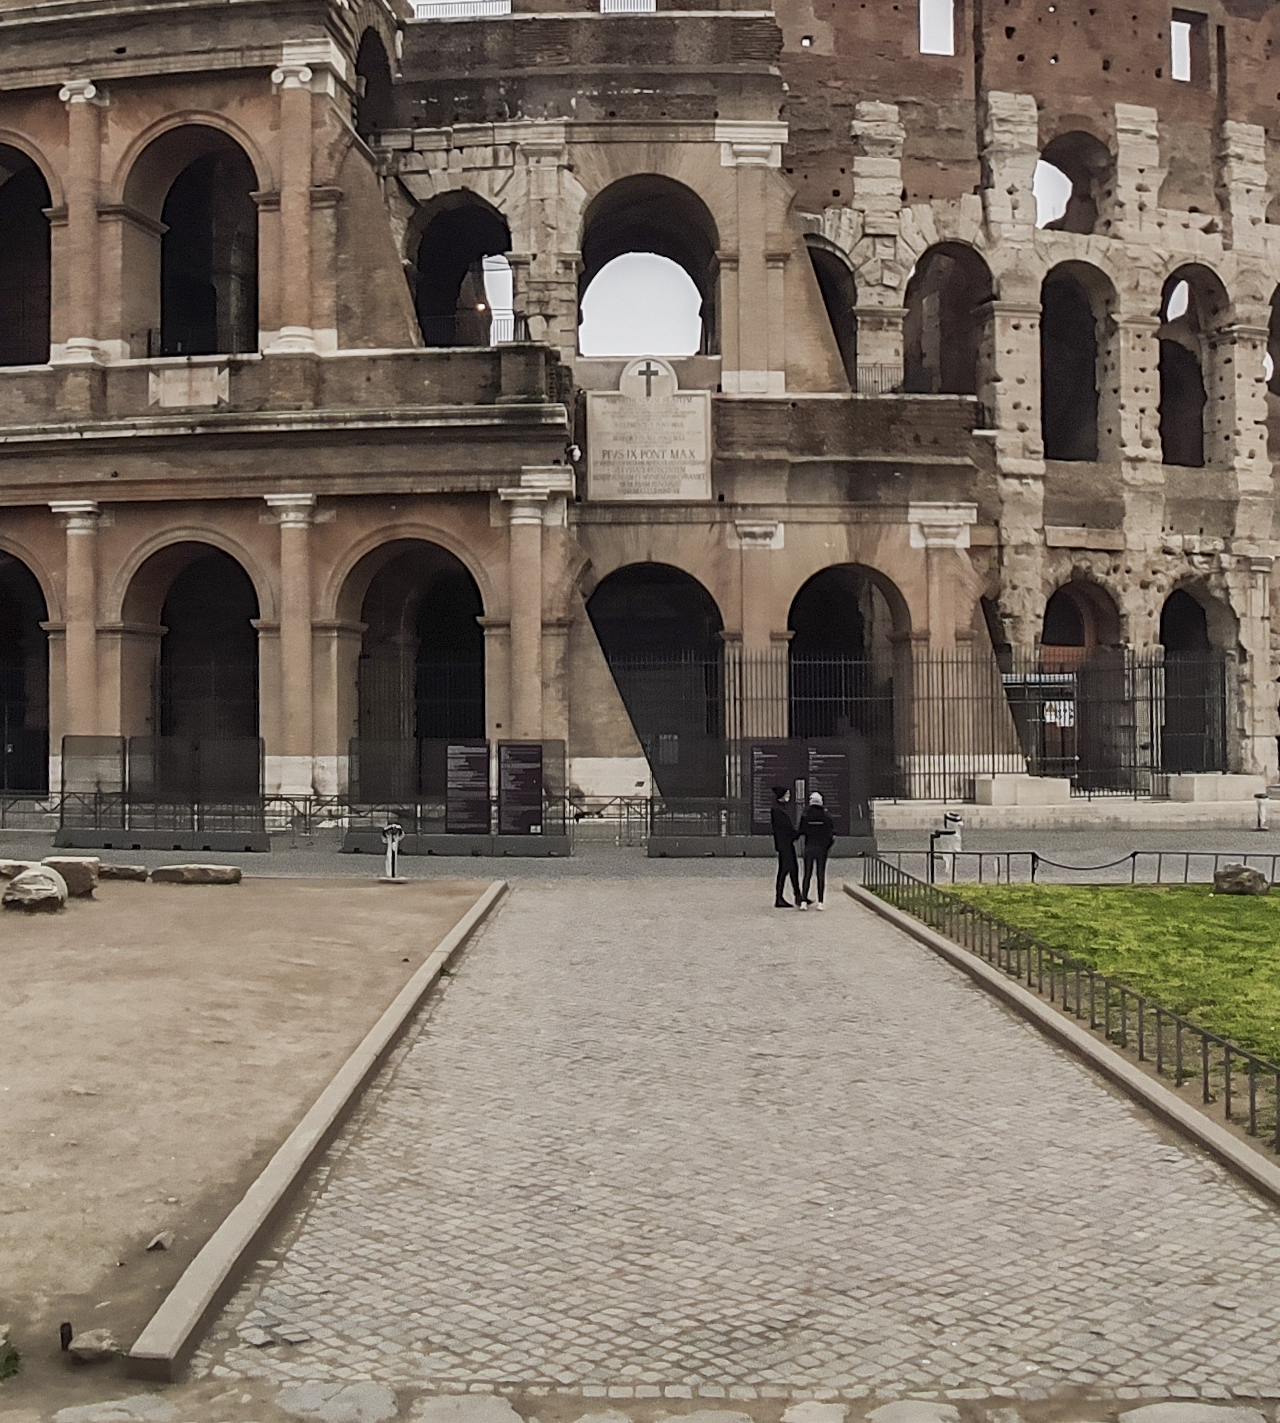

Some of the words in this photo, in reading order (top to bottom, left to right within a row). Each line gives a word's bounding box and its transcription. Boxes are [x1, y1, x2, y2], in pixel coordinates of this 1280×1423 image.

[602, 449, 624, 459] PIVS
[627, 449, 637, 459] IX
[640, 449, 666, 459] PONT
[670, 449, 695, 459] MAX
